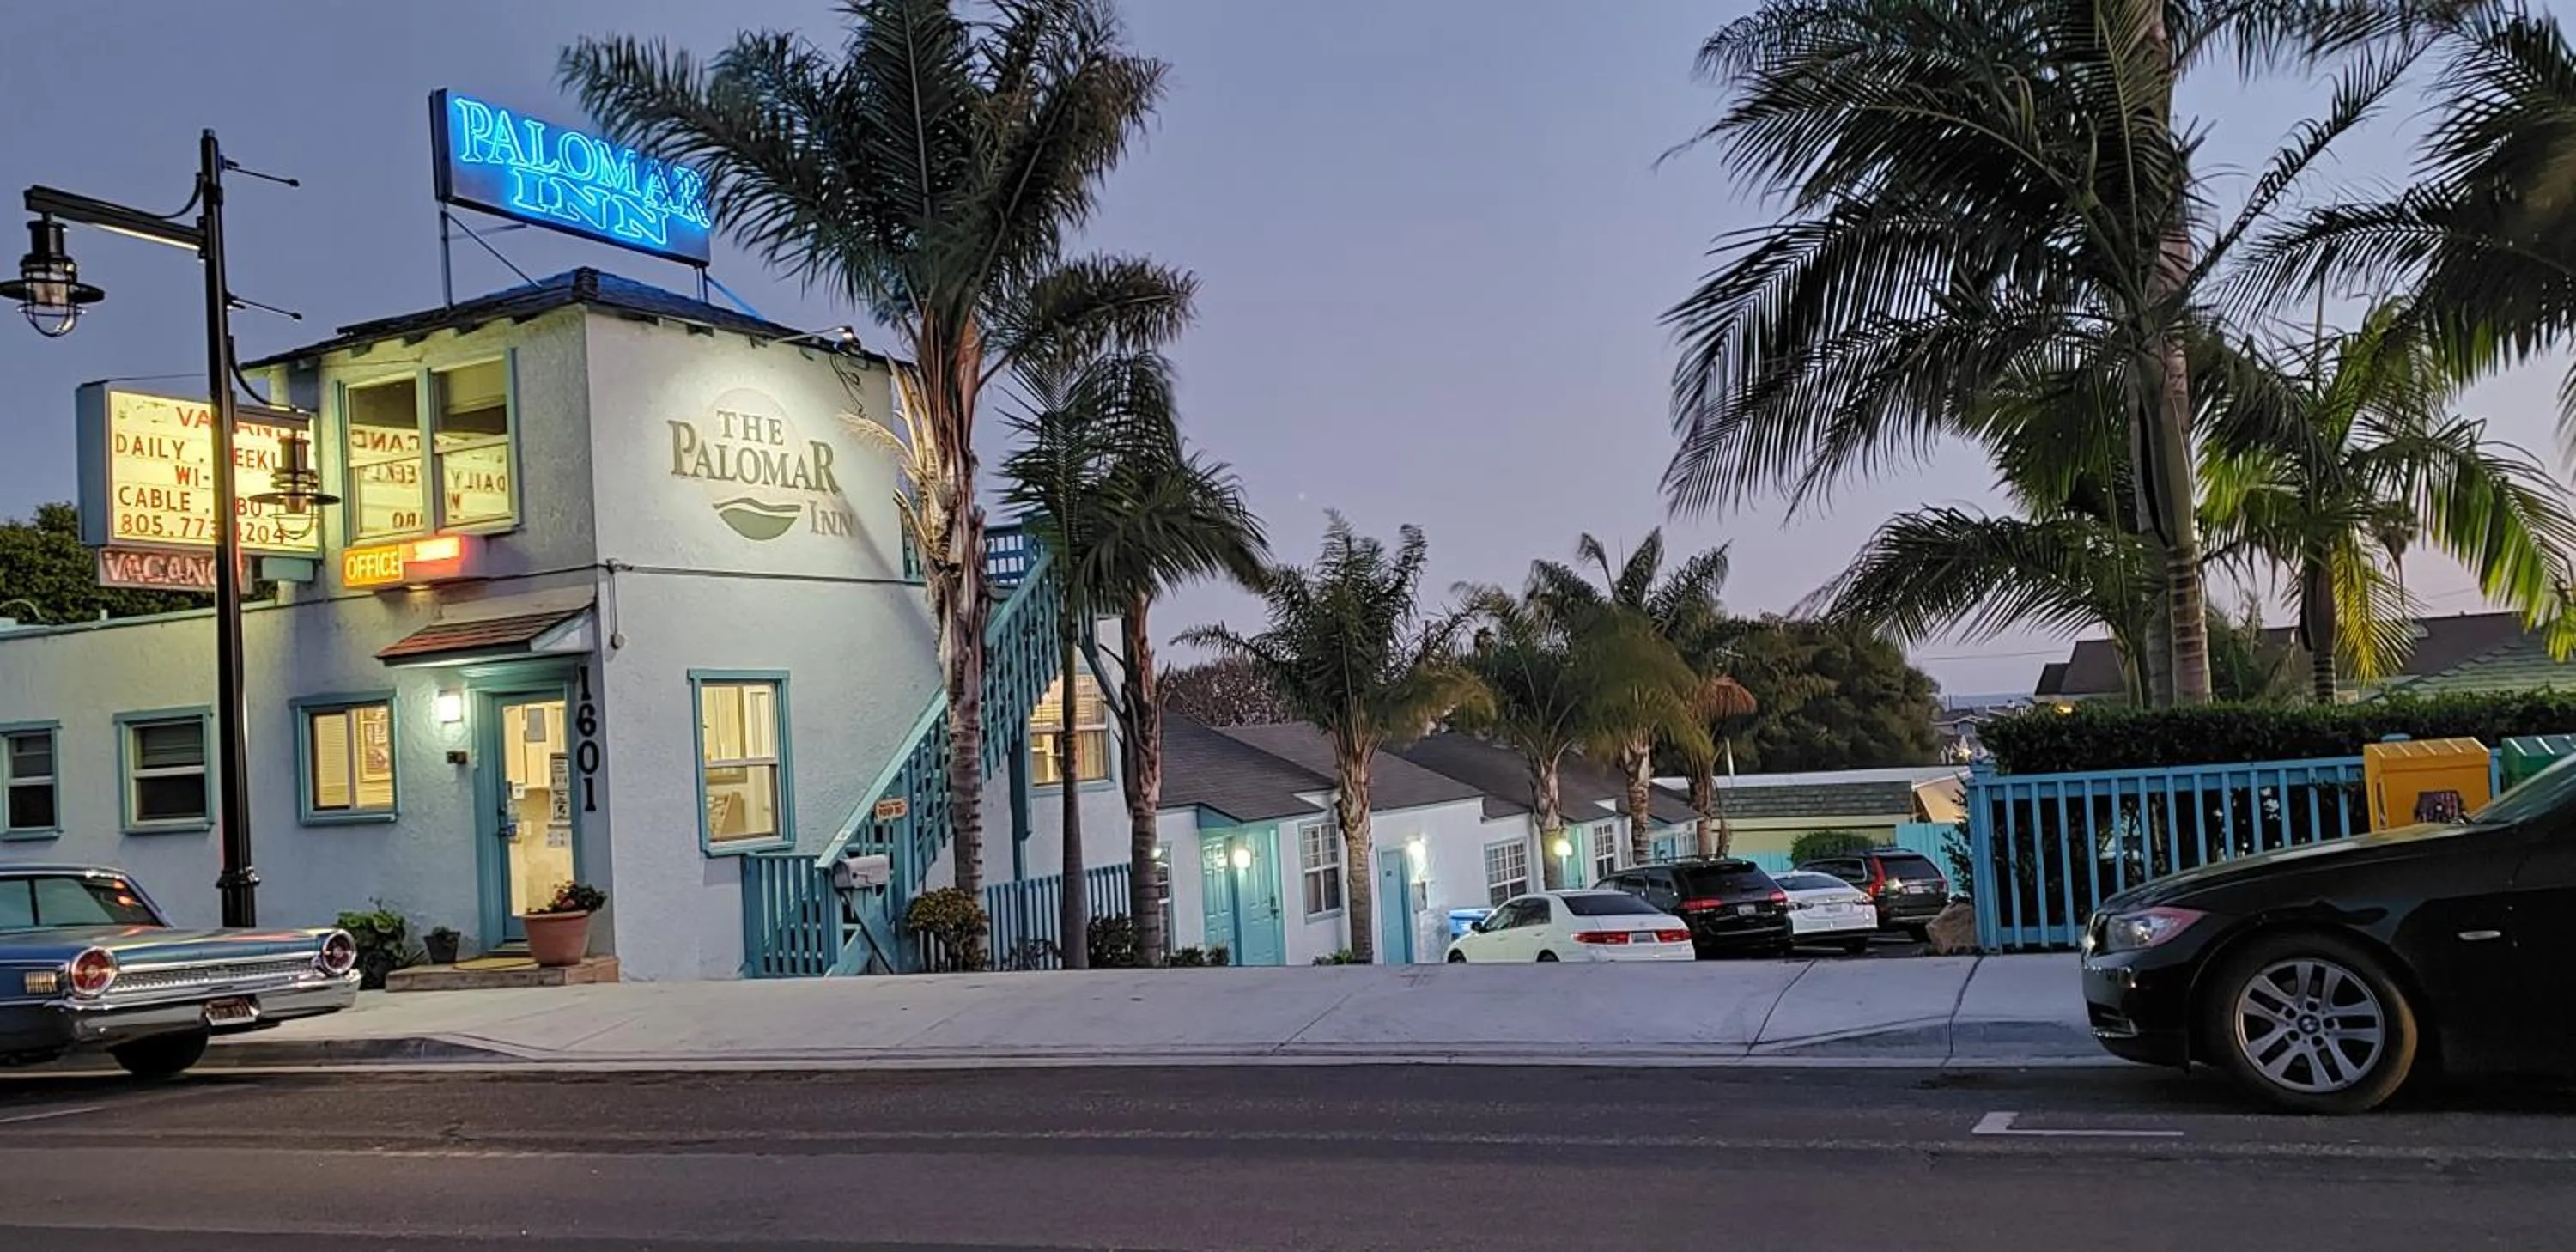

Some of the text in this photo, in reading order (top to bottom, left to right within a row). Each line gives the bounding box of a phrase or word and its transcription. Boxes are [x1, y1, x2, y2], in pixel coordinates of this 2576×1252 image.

[453, 97, 712, 228] PALOMAR
[511, 167, 668, 245] INN
[716, 410, 784, 446] THE
[115, 433, 185, 461] DAILY
[667, 419, 841, 495] PALOMAR
[118, 485, 191, 513] CABLE
[808, 500, 854, 537] INN
[345, 550, 400, 580] OFFICE
[575, 666, 600, 812] 1601
